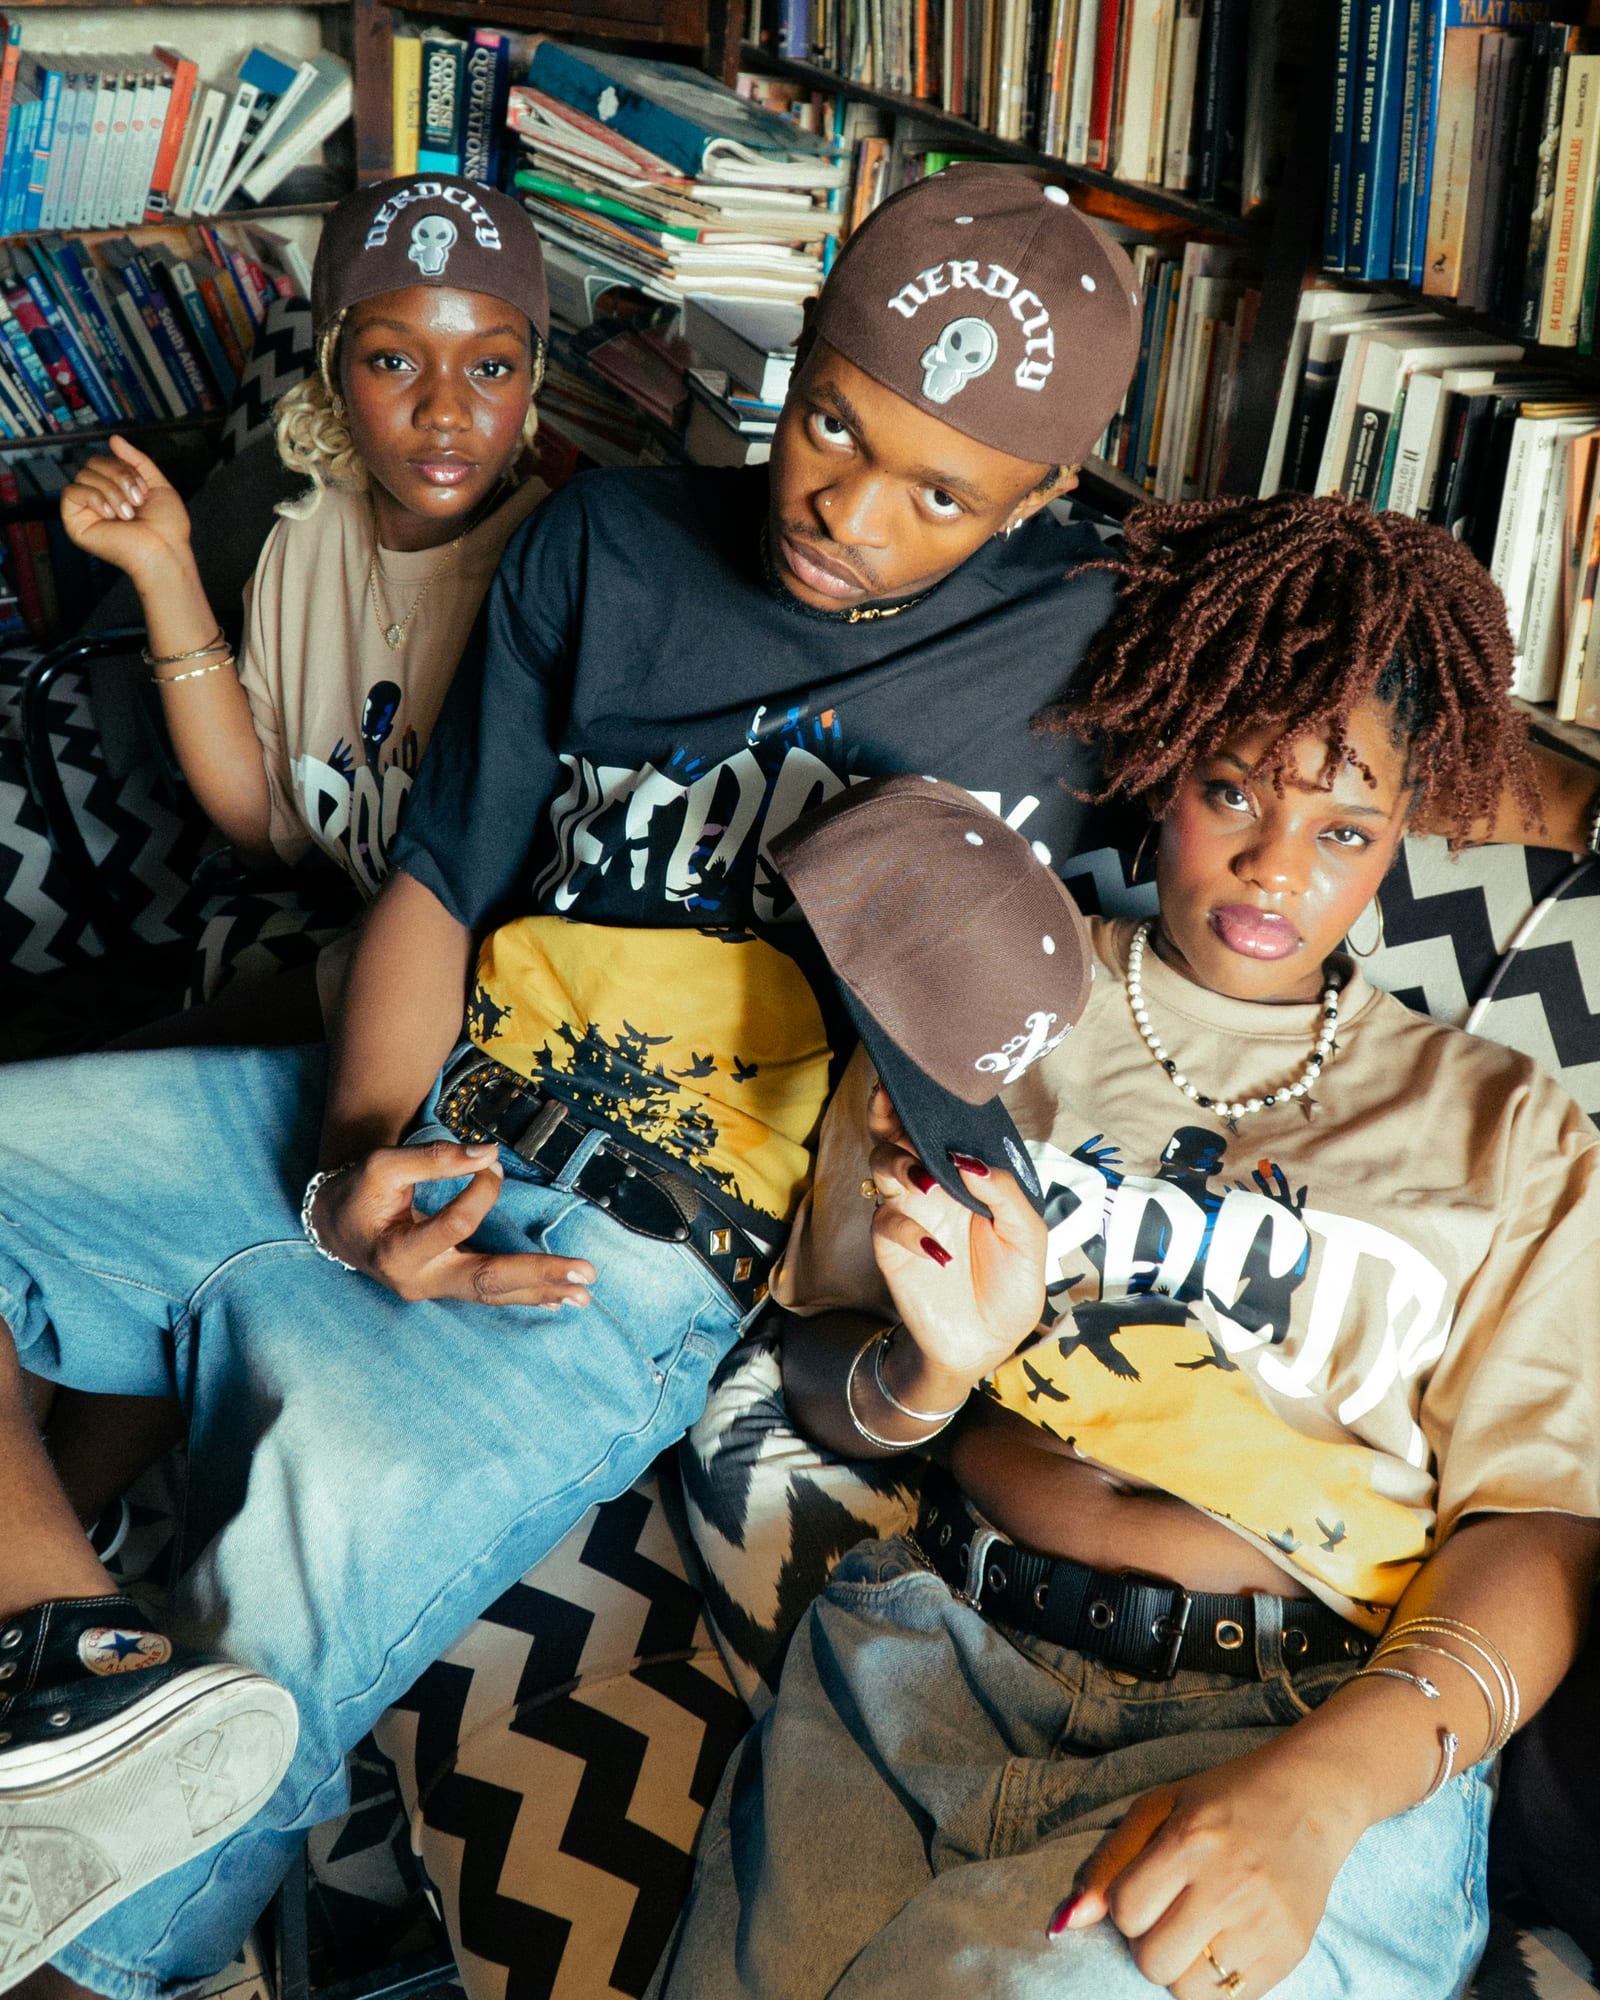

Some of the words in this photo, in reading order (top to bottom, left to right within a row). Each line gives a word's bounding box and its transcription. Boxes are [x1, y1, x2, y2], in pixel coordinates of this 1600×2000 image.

[1367, 4, 1381, 61] TURKEY
[426, 55, 443, 126] OXFORD
[440, 57, 457, 128] CONCISE
[1338, 58, 1348, 73] IN
[1365, 66, 1376, 82] IN
[464, 47, 490, 180] QUOTATIONS
[1335, 78, 1347, 133] EUROPE
[1360, 87, 1374, 144] EUROPE
[1356, 172, 1366, 215] TURGUT
[158, 306, 185, 350] South
[178, 351, 205, 393] Africa
[887, 260, 1055, 391] NERDCITY
